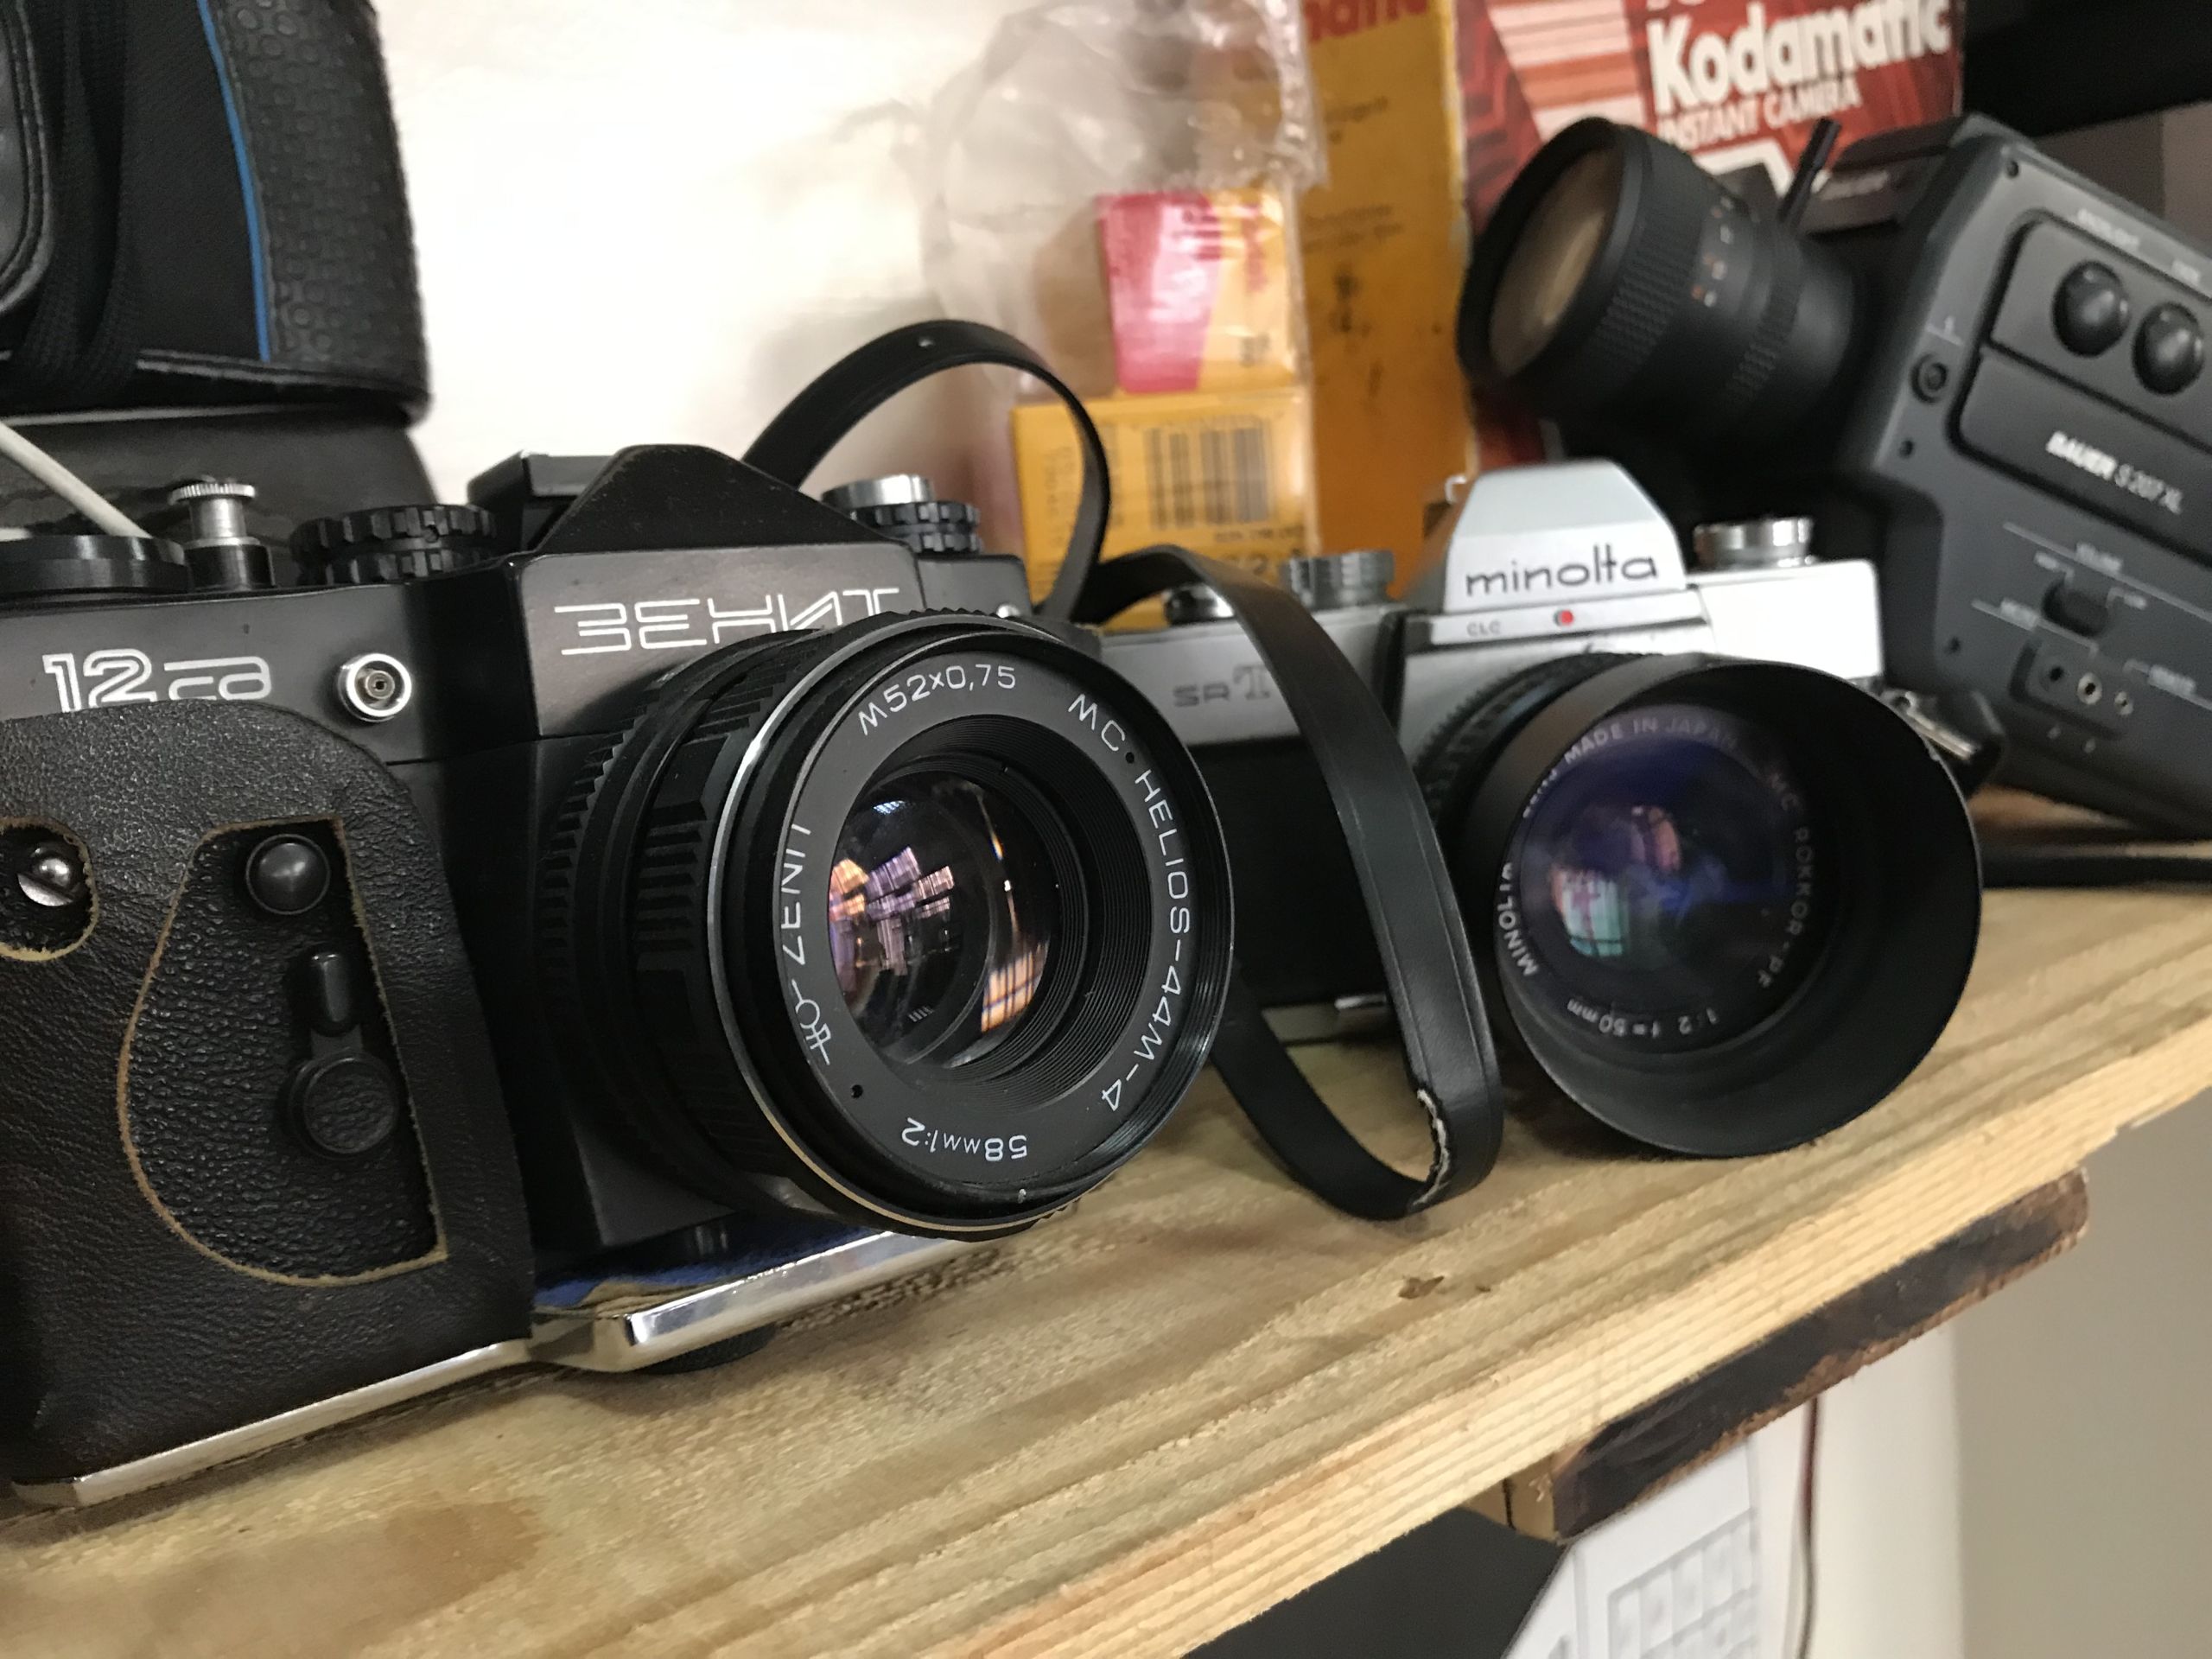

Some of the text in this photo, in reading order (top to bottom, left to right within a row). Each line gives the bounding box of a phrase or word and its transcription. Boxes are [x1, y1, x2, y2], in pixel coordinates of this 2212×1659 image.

[1465, 544, 1658, 596] minolta
[1466, 620, 1502, 637] CLC
[1563, 722, 1624, 765] MADE
[1632, 716, 1659, 734] IN
